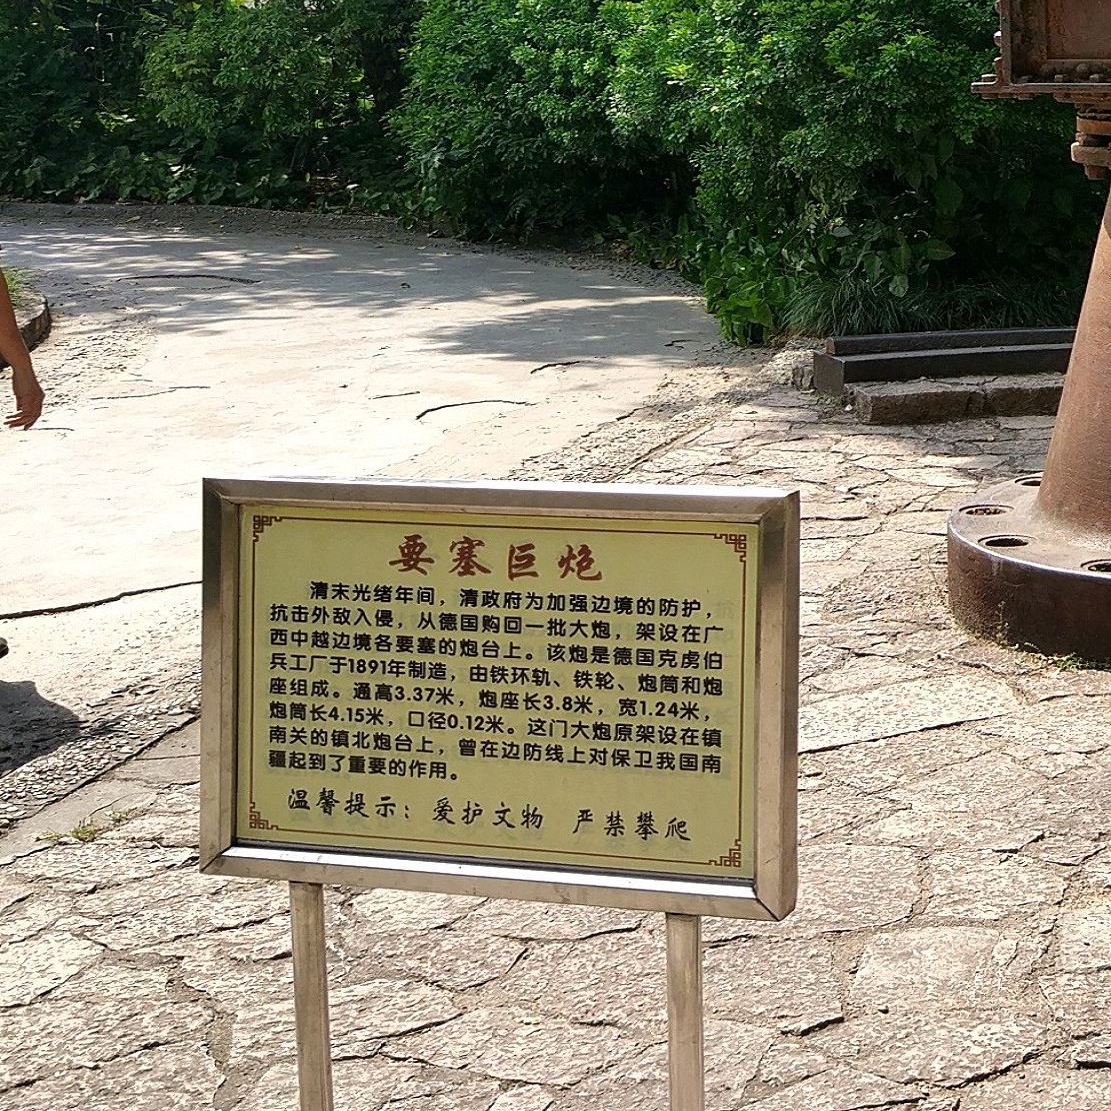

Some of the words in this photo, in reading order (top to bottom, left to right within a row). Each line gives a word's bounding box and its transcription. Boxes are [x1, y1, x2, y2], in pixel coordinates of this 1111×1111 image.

[389, 533, 603, 581] 要塞巨炮
[269, 603, 724, 644] 抗击外敌入侵，从德国购回一批大炮，架设在广
[268, 725, 722, 774] 南关的镇北炮台上，曾在边防线上对保卫我国南
[268, 749, 458, 781] 疆起到了重要的作用。
[572, 809, 691, 841] 严禁攀爬
